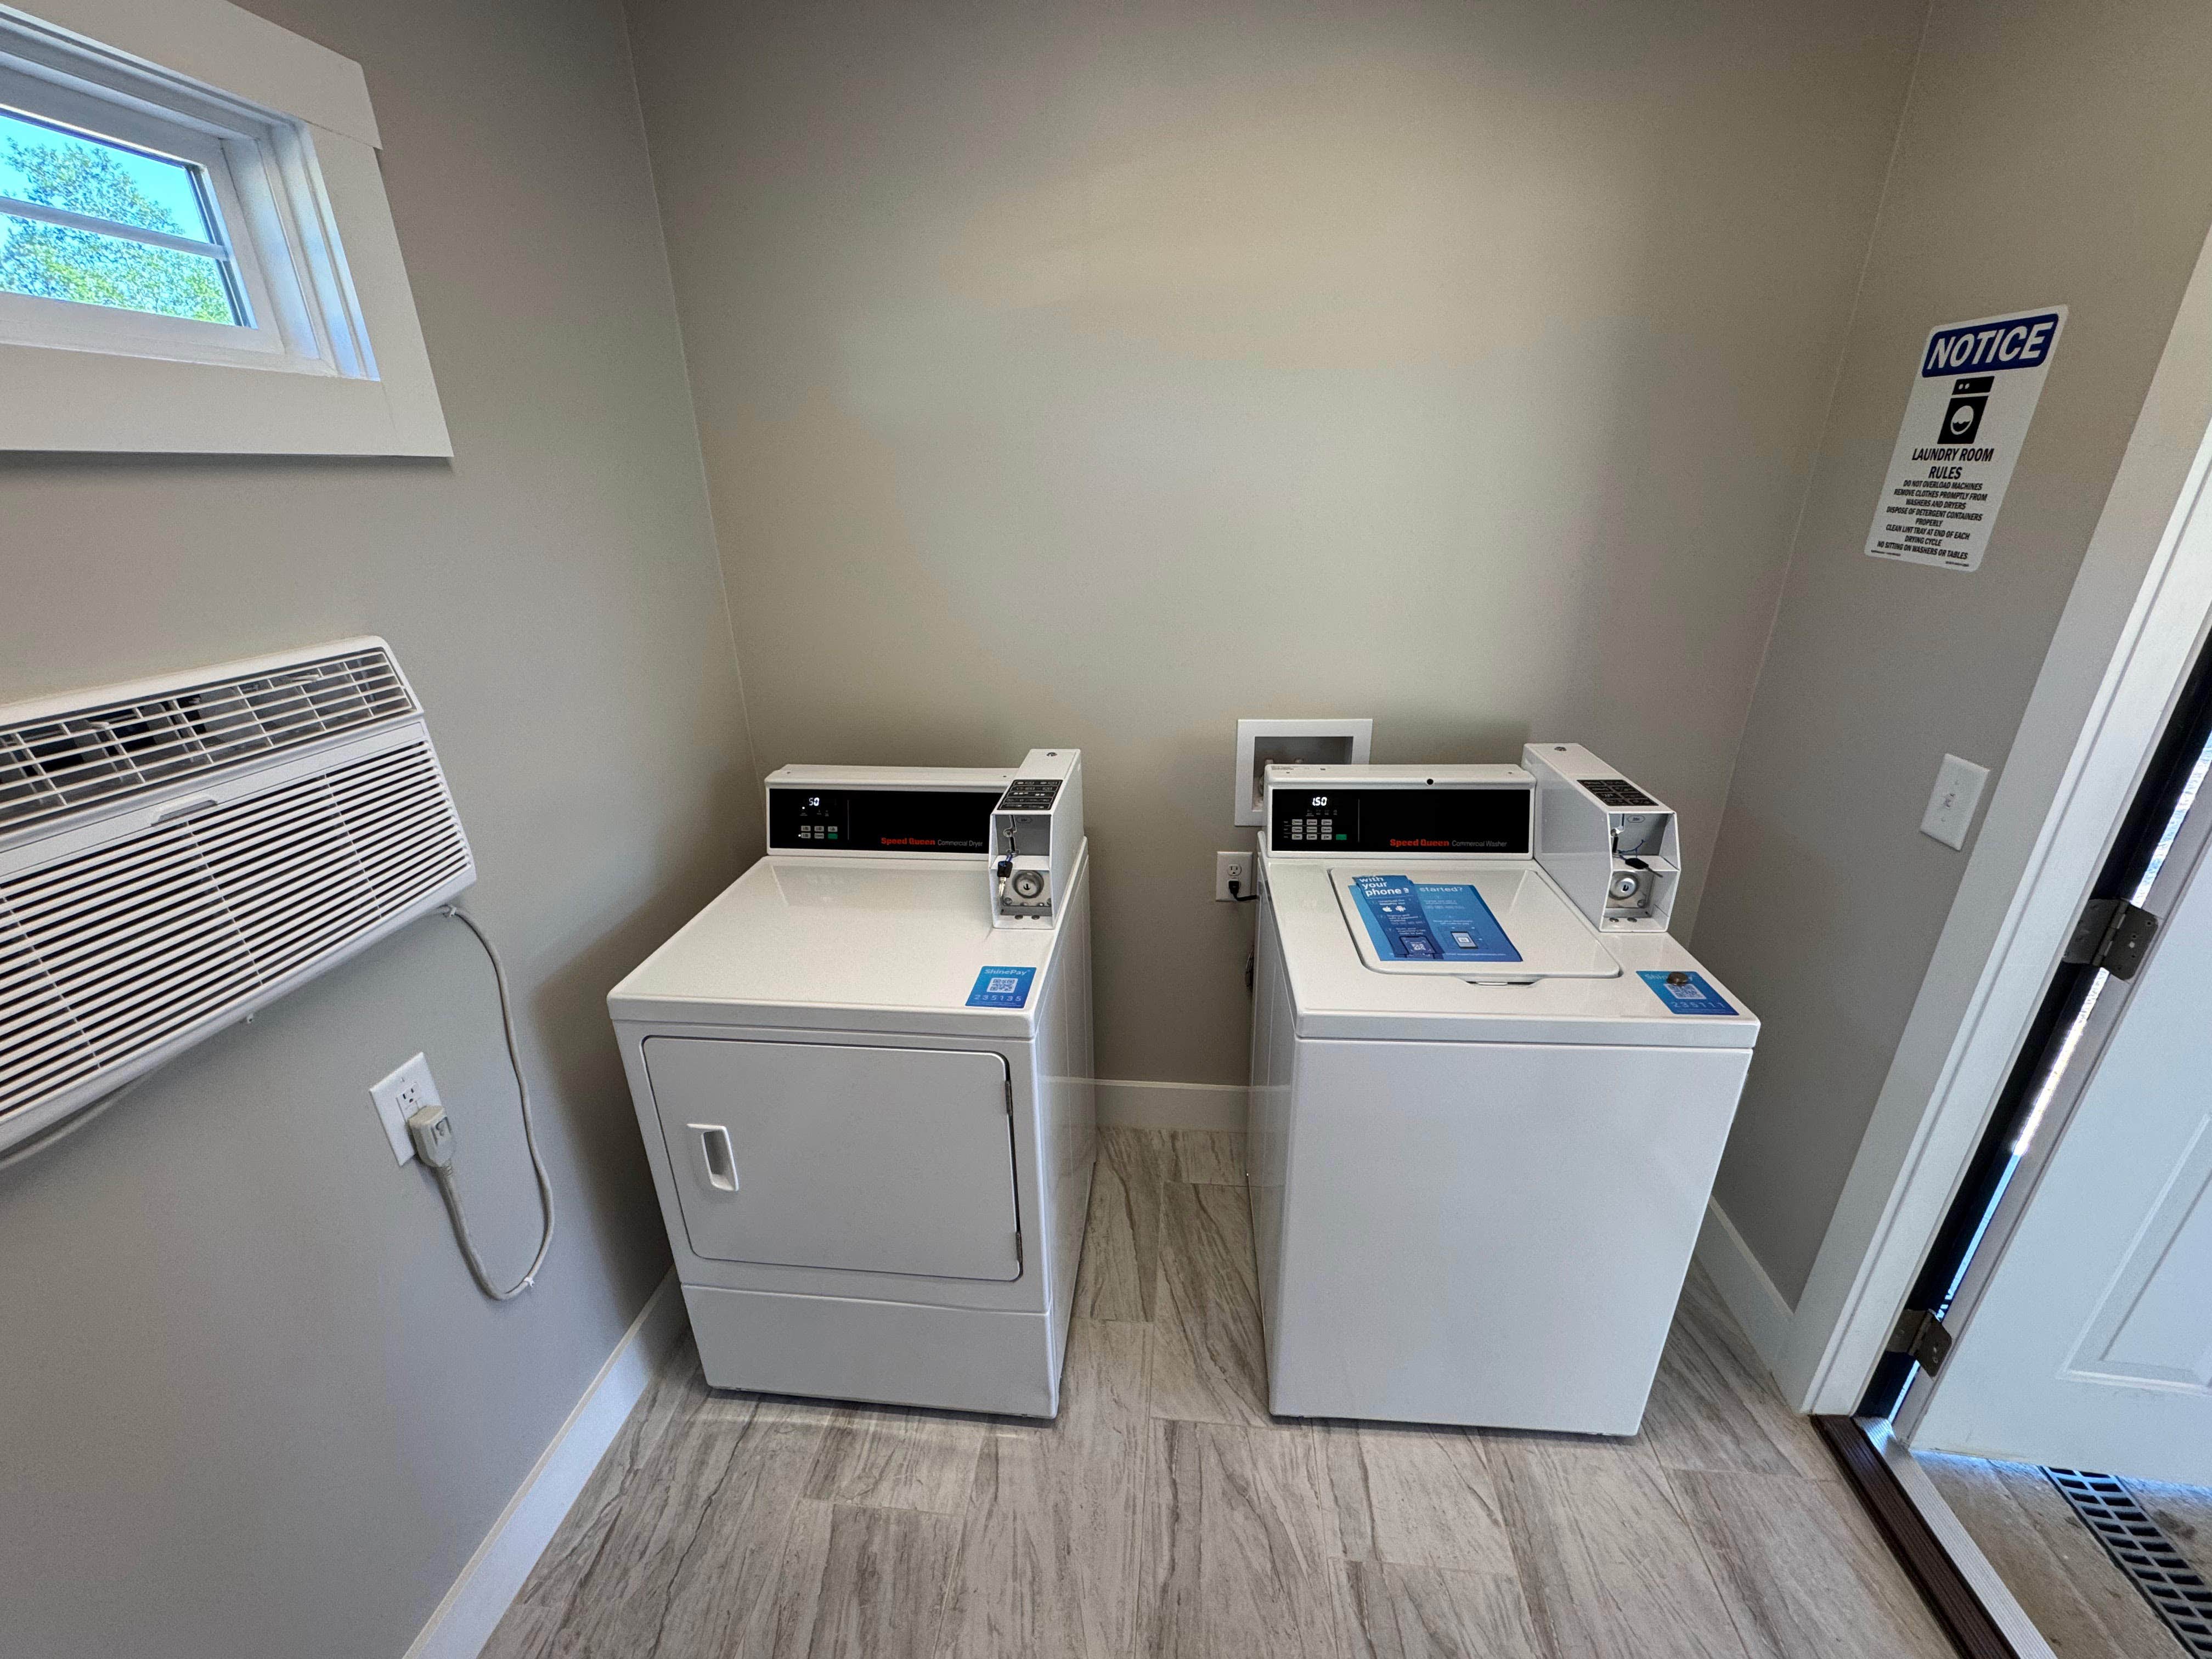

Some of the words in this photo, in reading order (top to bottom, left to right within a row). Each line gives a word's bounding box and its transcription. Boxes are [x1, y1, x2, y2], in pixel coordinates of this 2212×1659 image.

[1927, 321, 2055, 370] NOTICE
[1912, 448, 1957, 461] LAUNDRY
[1959, 448, 1994, 461] ROOM
[1928, 466, 1962, 479] RULES
[1922, 481, 1951, 489] OVERLOAD
[1951, 482, 1983, 490] MACHINES
[1915, 489, 1939, 498] CLOTHES
[1939, 491, 1970, 500] PROMPTLY
[1969, 493, 1988, 501] FROM
[1906, 499, 1931, 507] WASHERS
[1943, 501, 1967, 510] DRYERS
[1915, 509, 1947, 518] DETERGENT
[1947, 511, 1984, 521] CONTAINERS
[1915, 518, 1943, 527] PROPERLY
[1886, 524, 1902, 532] CLEAN
[1914, 527, 1927, 535] TRAY
[1934, 529, 1945, 537] END
[1954, 532, 1970, 540] EACH
[1905, 535, 1925, 544] DRYING
[1925, 538, 1942, 546] CYCLE
[1885, 541, 1904, 550] SITTING
[1912, 545, 1938, 555] WASHERS
[1947, 550, 1968, 560] TABLES
[881, 837, 907, 845] Speed
[1390, 839, 1419, 847] Speed
[1365, 888, 1402, 897] phone
